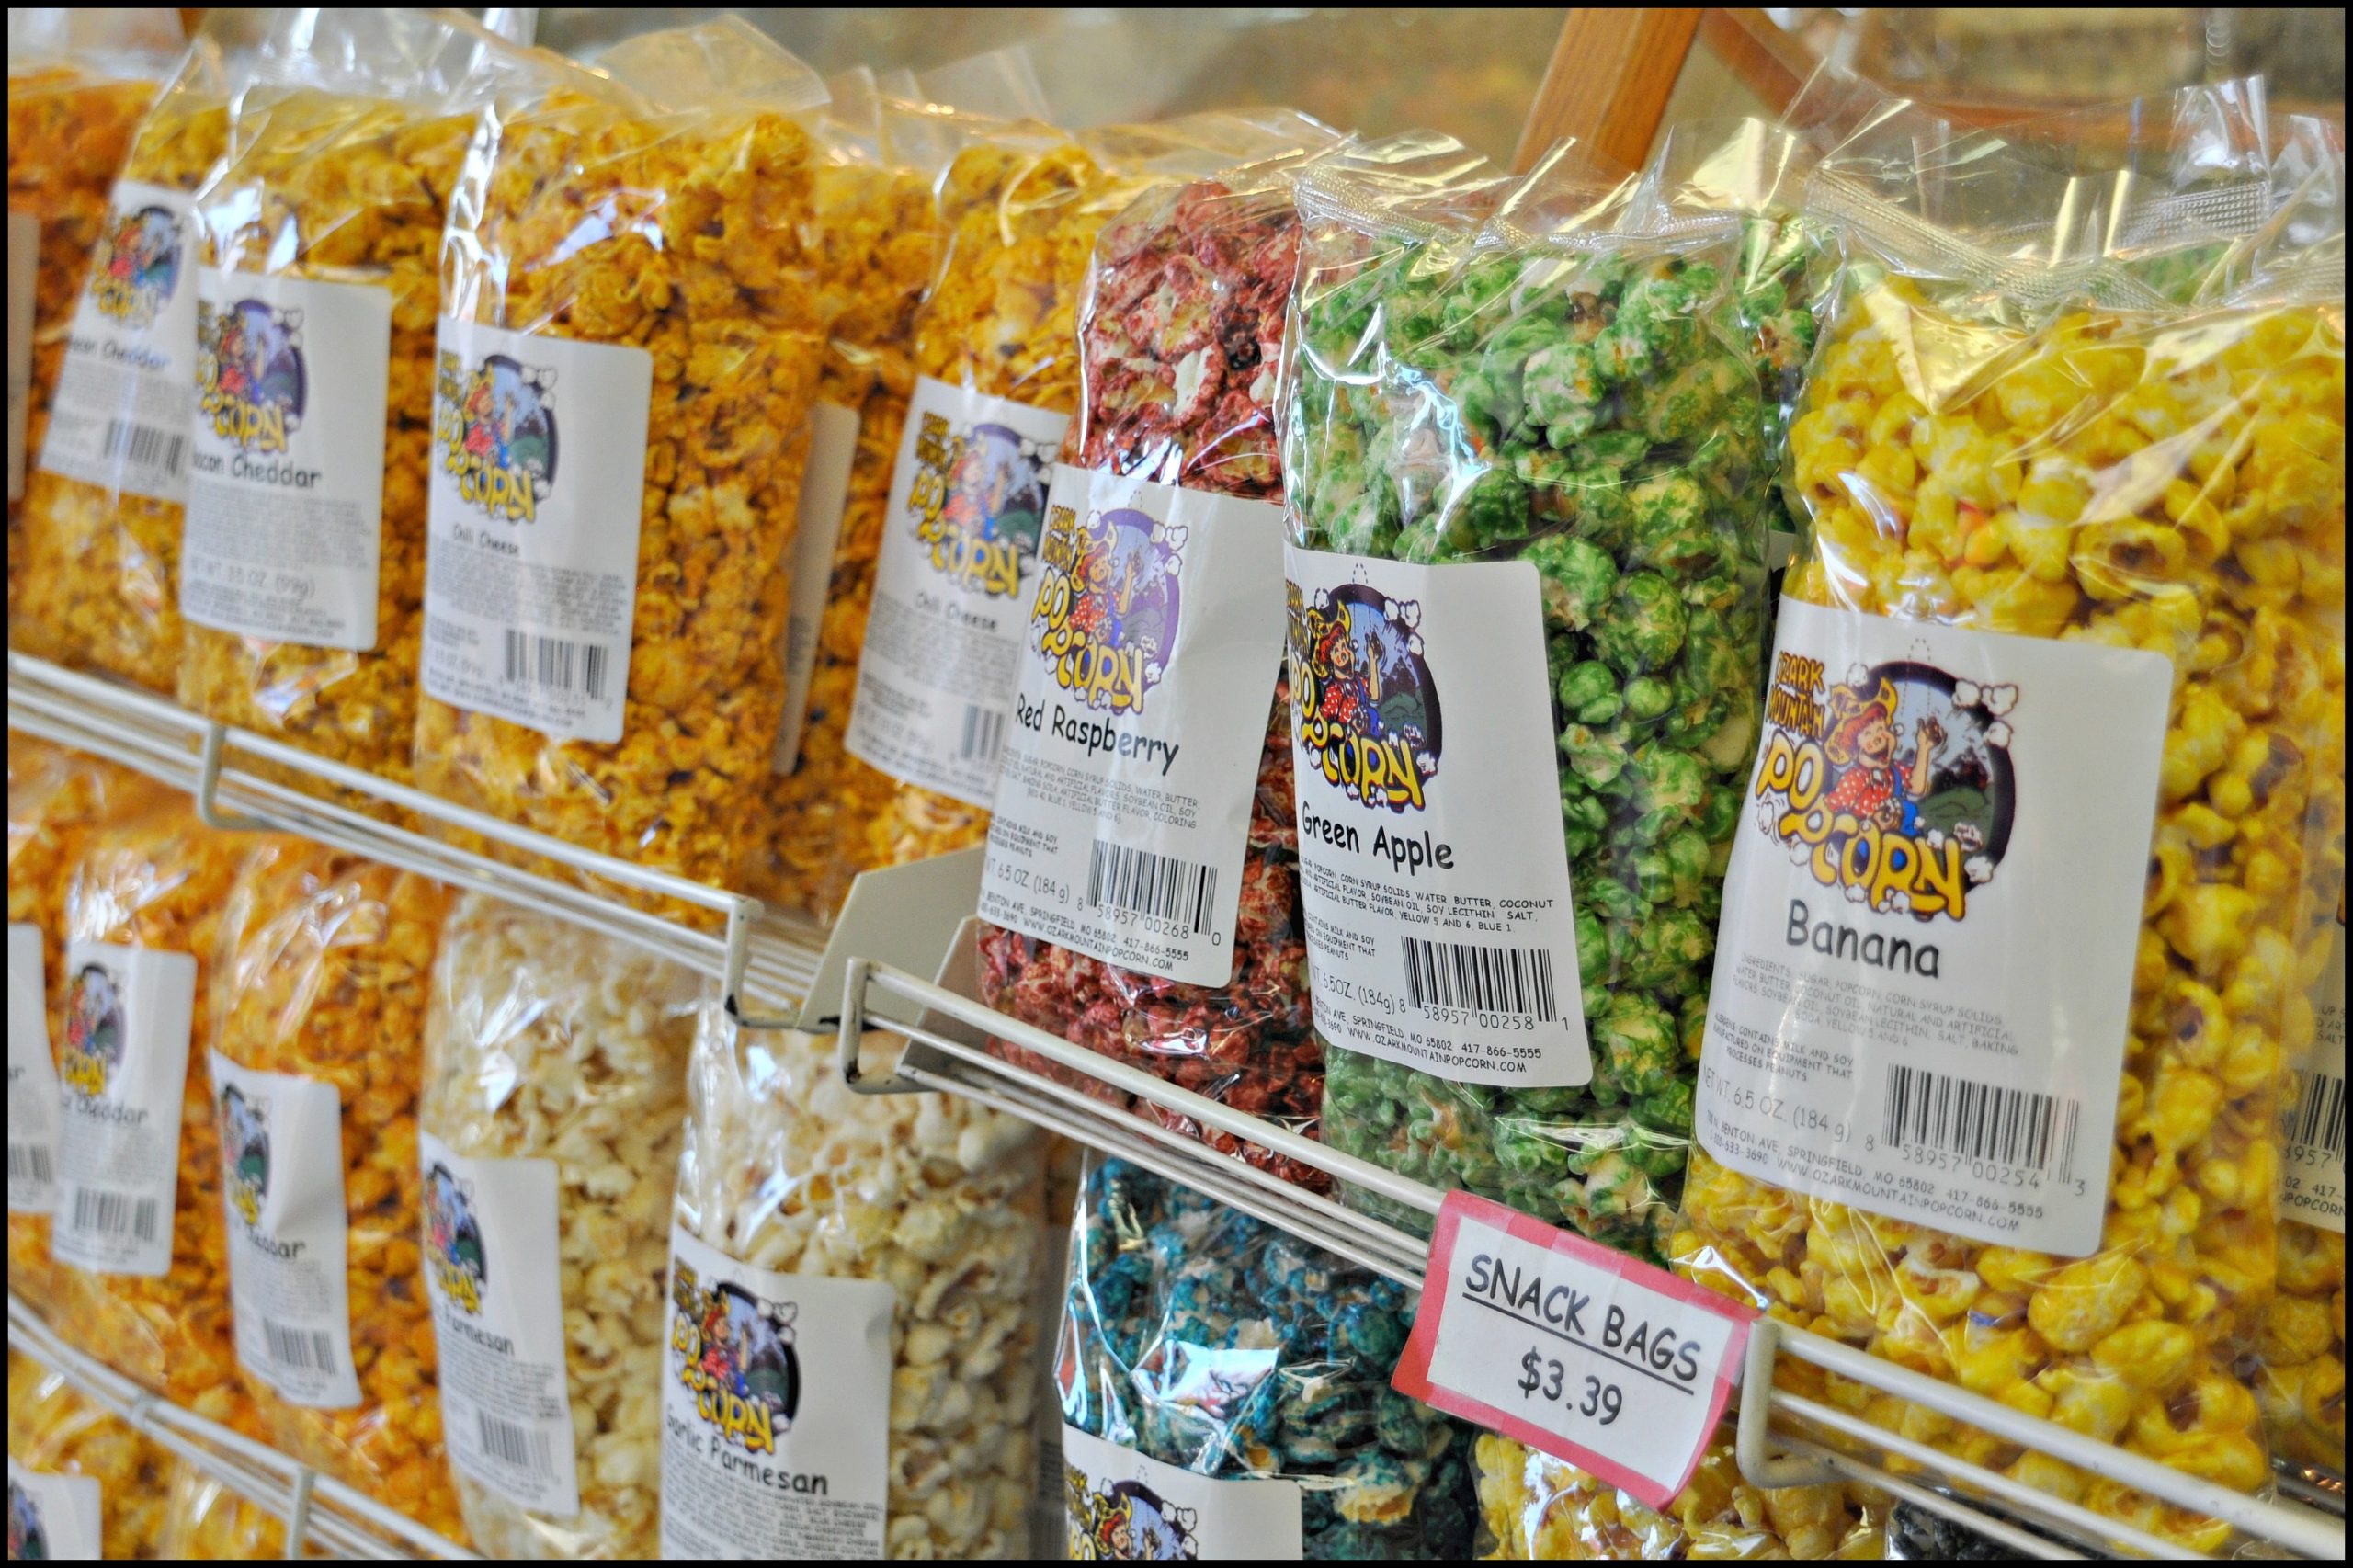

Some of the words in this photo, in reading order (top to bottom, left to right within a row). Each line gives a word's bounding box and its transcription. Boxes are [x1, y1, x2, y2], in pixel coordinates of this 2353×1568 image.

[232, 454, 322, 488] Cheddar
[480, 528, 520, 554] Cheese
[1775, 650, 1826, 694] OZARK
[1766, 683, 1826, 738] MOUNTAIN
[1016, 693, 1045, 732] Red
[1052, 704, 1179, 776] Raspberry
[1154, 812, 1197, 829] COLORING
[1179, 808, 1198, 818] SOY
[1302, 801, 1360, 854] Green
[1373, 825, 1455, 877] Apple
[1341, 873, 1358, 886] CORN
[1360, 879, 1381, 891] SYRUP
[1499, 899, 1553, 909] COCONUT
[1371, 892, 1404, 908] SOYBEAN
[1427, 904, 1444, 915] SOY
[1448, 907, 1495, 919] LECITHIN
[1342, 896, 1368, 911] BUTTER
[1399, 911, 1429, 925] YELLOW
[1434, 916, 1439, 926] 5
[1443, 918, 1461, 928] AND
[1478, 921, 1503, 932] BLUE
[1358, 945, 1376, 957] THAT
[1361, 935, 1375, 946] SOY
[1786, 898, 1940, 981] Banana
[1424, 1005, 1471, 1027] 58957
[1479, 1013, 1535, 1030] 00258
[1868, 1003, 1916, 1022] NATURAL
[1922, 1014, 1944, 1028] AND
[1885, 992, 1916, 1007] CORN
[1919, 999, 1954, 1016] SYRUP
[1410, 1032, 1423, 1044] MO
[1426, 1038, 1452, 1051] 65802
[1461, 1043, 1542, 1059] 417-866-5555
[1738, 1025, 1780, 1048] CONTAINS
[1783, 1039, 1806, 1054] MILK
[1809, 1048, 1830, 1062] AND
[1833, 1054, 1854, 1068] SOY
[1825, 1005, 1873, 1026] SOYBEAN
[1972, 1039, 2019, 1055] BAKING
[1878, 1031, 1899, 1045] AND
[1347, 1025, 1528, 1073] WWW.OZARKMOUNTAINPOPCORN.COM
[1751, 1043, 1765, 1057] ON
[1767, 1049, 1823, 1073] EQUIPMENT
[1826, 1064, 1854, 1081] THAT
[1765, 1061, 1808, 1083] PEANUTS
[1733, 1086, 1755, 1110] 6.5
[1902, 1143, 1961, 1173] 58957
[1972, 1161, 2040, 1191] 00254
[1776, 1155, 2020, 1232] WWW.OZARKMOUNTAINPOPCORN.COM
[1873, 1170, 1893, 1185] MO
[1898, 1176, 1936, 1196] 65802
[1945, 1187, 2045, 1220] 417-866-5555
[1465, 1253, 1591, 1336] SNACK
[1602, 1304, 1701, 1381] BAGS
[1517, 1345, 1623, 1426] $3.39
[710, 1434, 830, 1496] Parmesan
